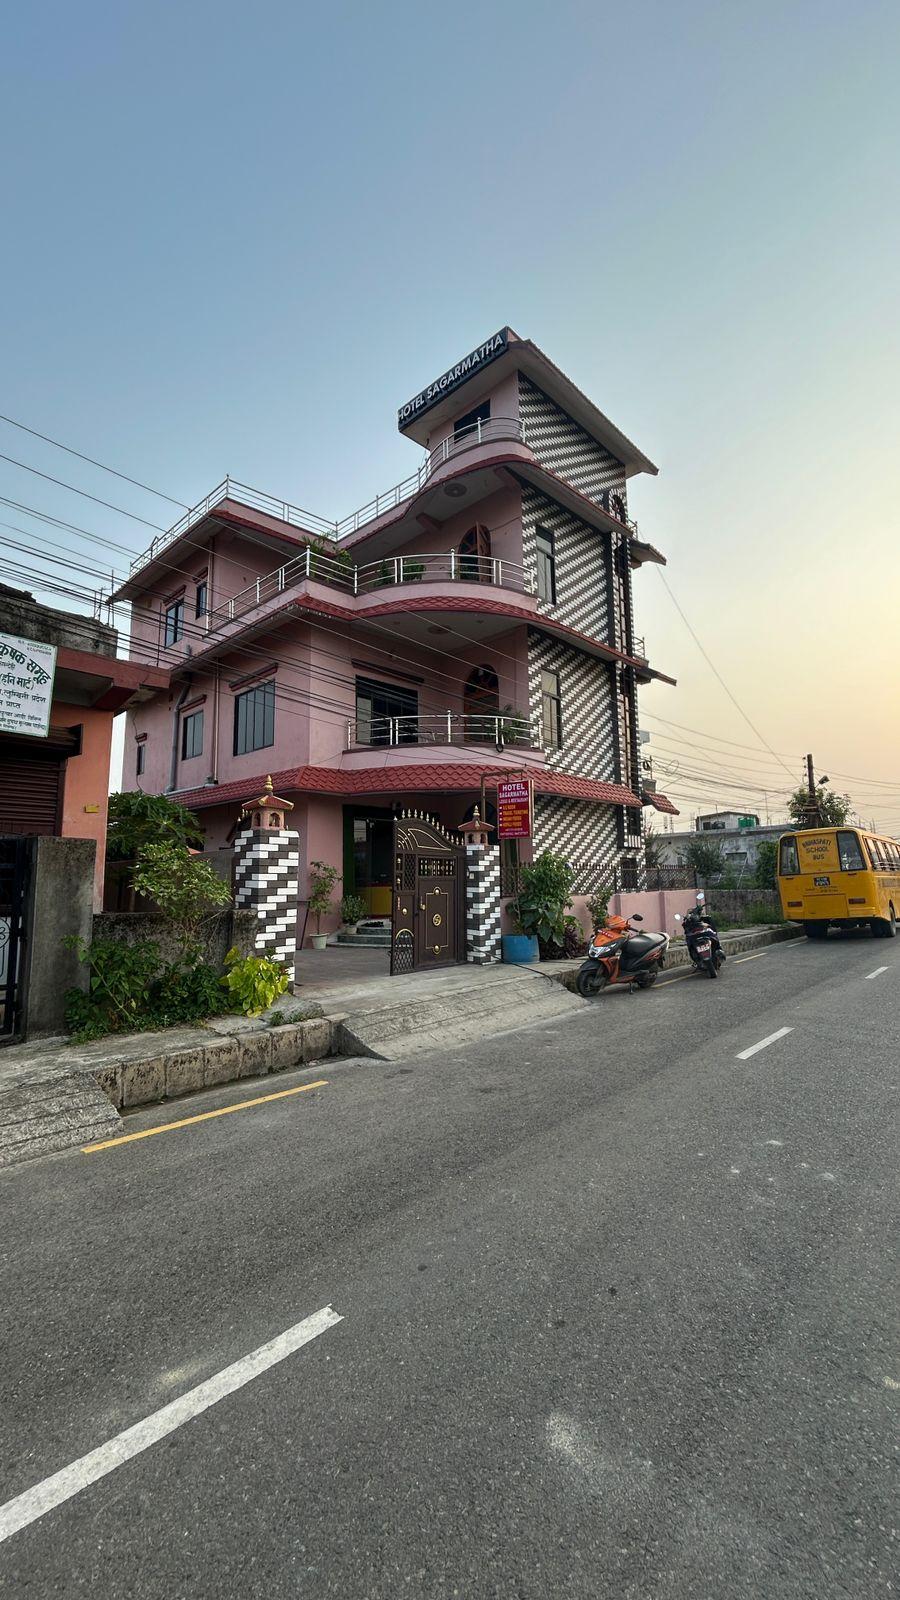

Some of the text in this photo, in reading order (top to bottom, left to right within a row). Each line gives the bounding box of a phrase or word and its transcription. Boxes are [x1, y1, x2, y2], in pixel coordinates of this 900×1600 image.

[398, 334, 503, 420] HOTEL SAGARMATHA
[26, 658, 51, 685] समूह
[500, 790, 528, 798] SAGARMATHA
[806, 846, 829, 854] SCHOOL
